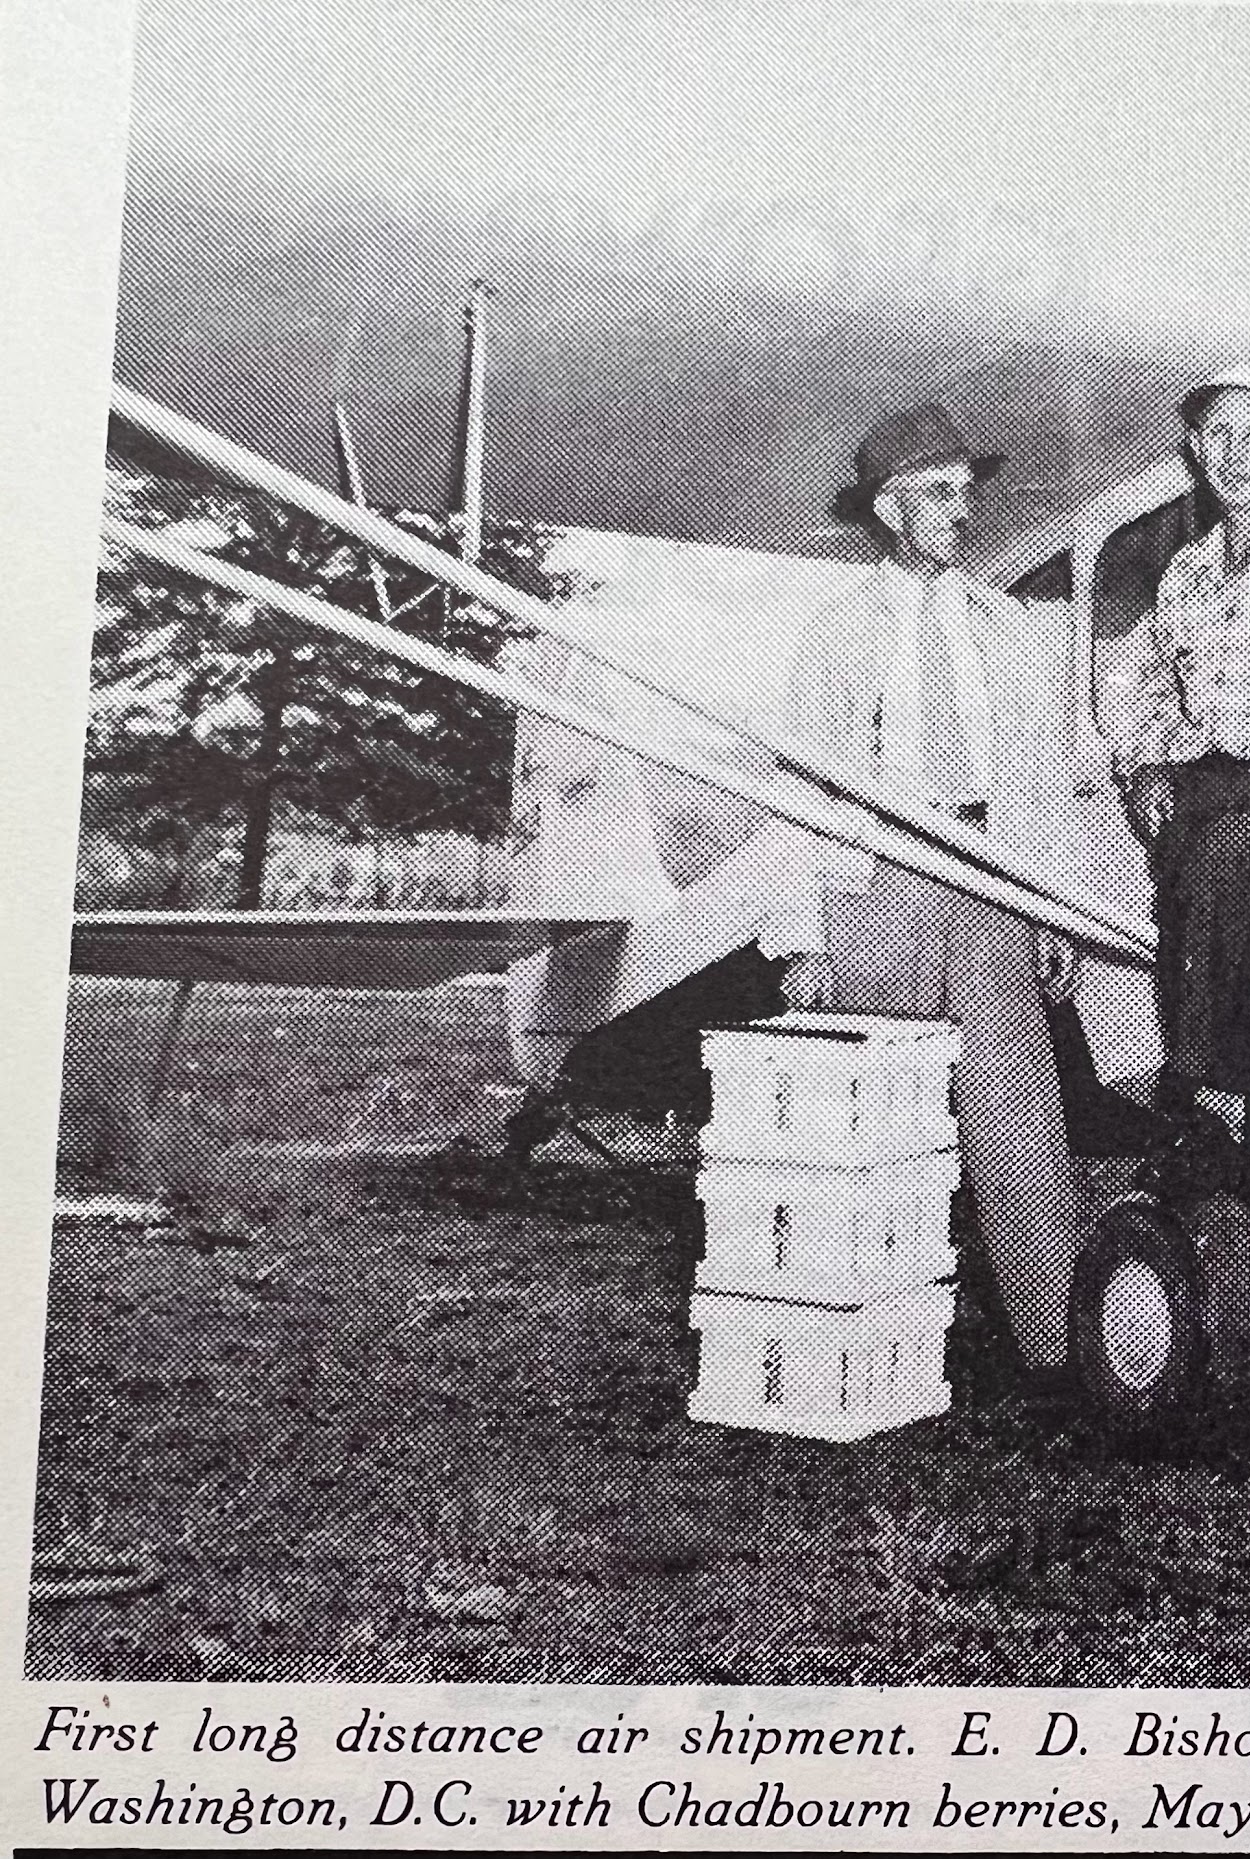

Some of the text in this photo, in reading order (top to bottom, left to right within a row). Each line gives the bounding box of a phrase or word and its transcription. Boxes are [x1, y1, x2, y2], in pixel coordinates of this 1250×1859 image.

[34, 1707, 160, 1753] First
[193, 1708, 298, 1763] long
[337, 1708, 543, 1754] distance
[578, 1712, 649, 1754] air
[681, 1711, 916, 1764] shipment.
[951, 1712, 1002, 1755] E.
[1036, 1712, 1089, 1755] D.
[43, 1779, 348, 1834] Washington,
[507, 1781, 611, 1827] with
[639, 1781, 910, 1828] Chadbourn
[933, 1782, 1119, 1834] berries,
